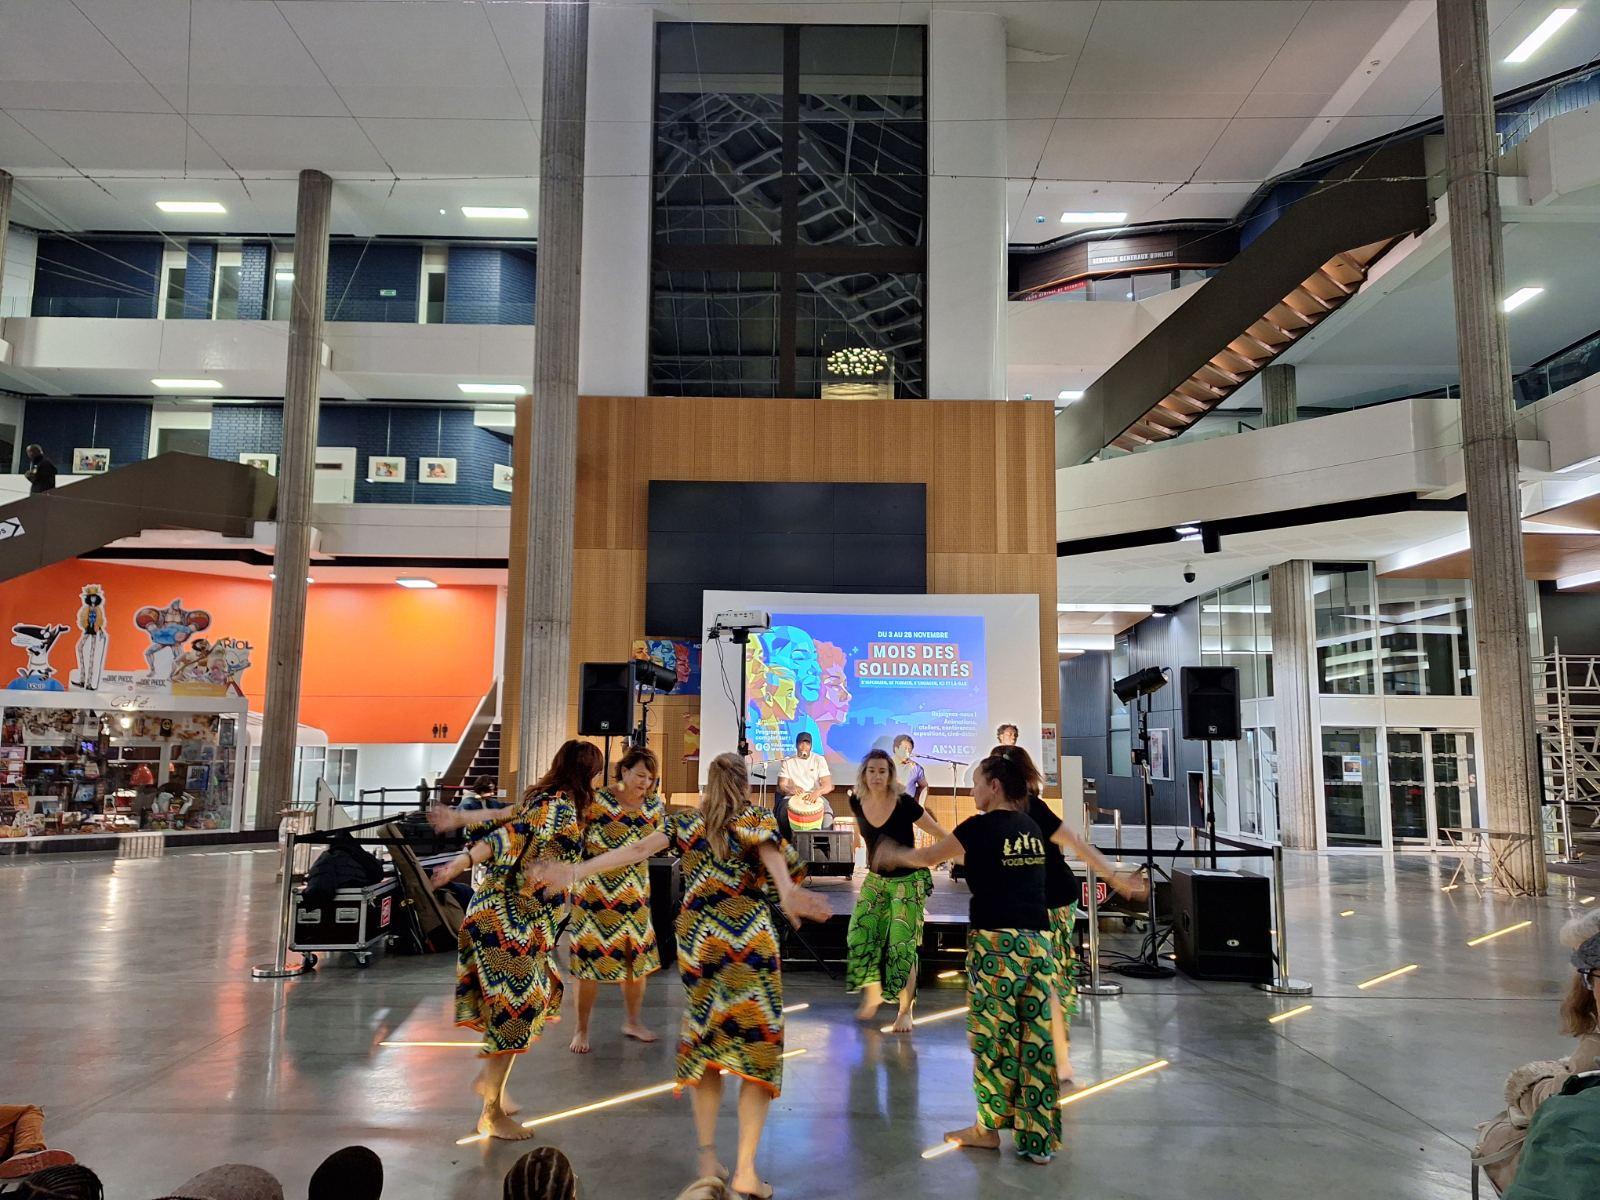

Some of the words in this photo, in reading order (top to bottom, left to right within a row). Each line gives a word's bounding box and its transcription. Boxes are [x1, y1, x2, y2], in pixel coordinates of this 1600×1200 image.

[873, 644, 916, 658] MOIS
[922, 645, 954, 659] DES
[858, 661, 970, 676] SOLIDARITÉS
[932, 744, 976, 754] ANNECY
